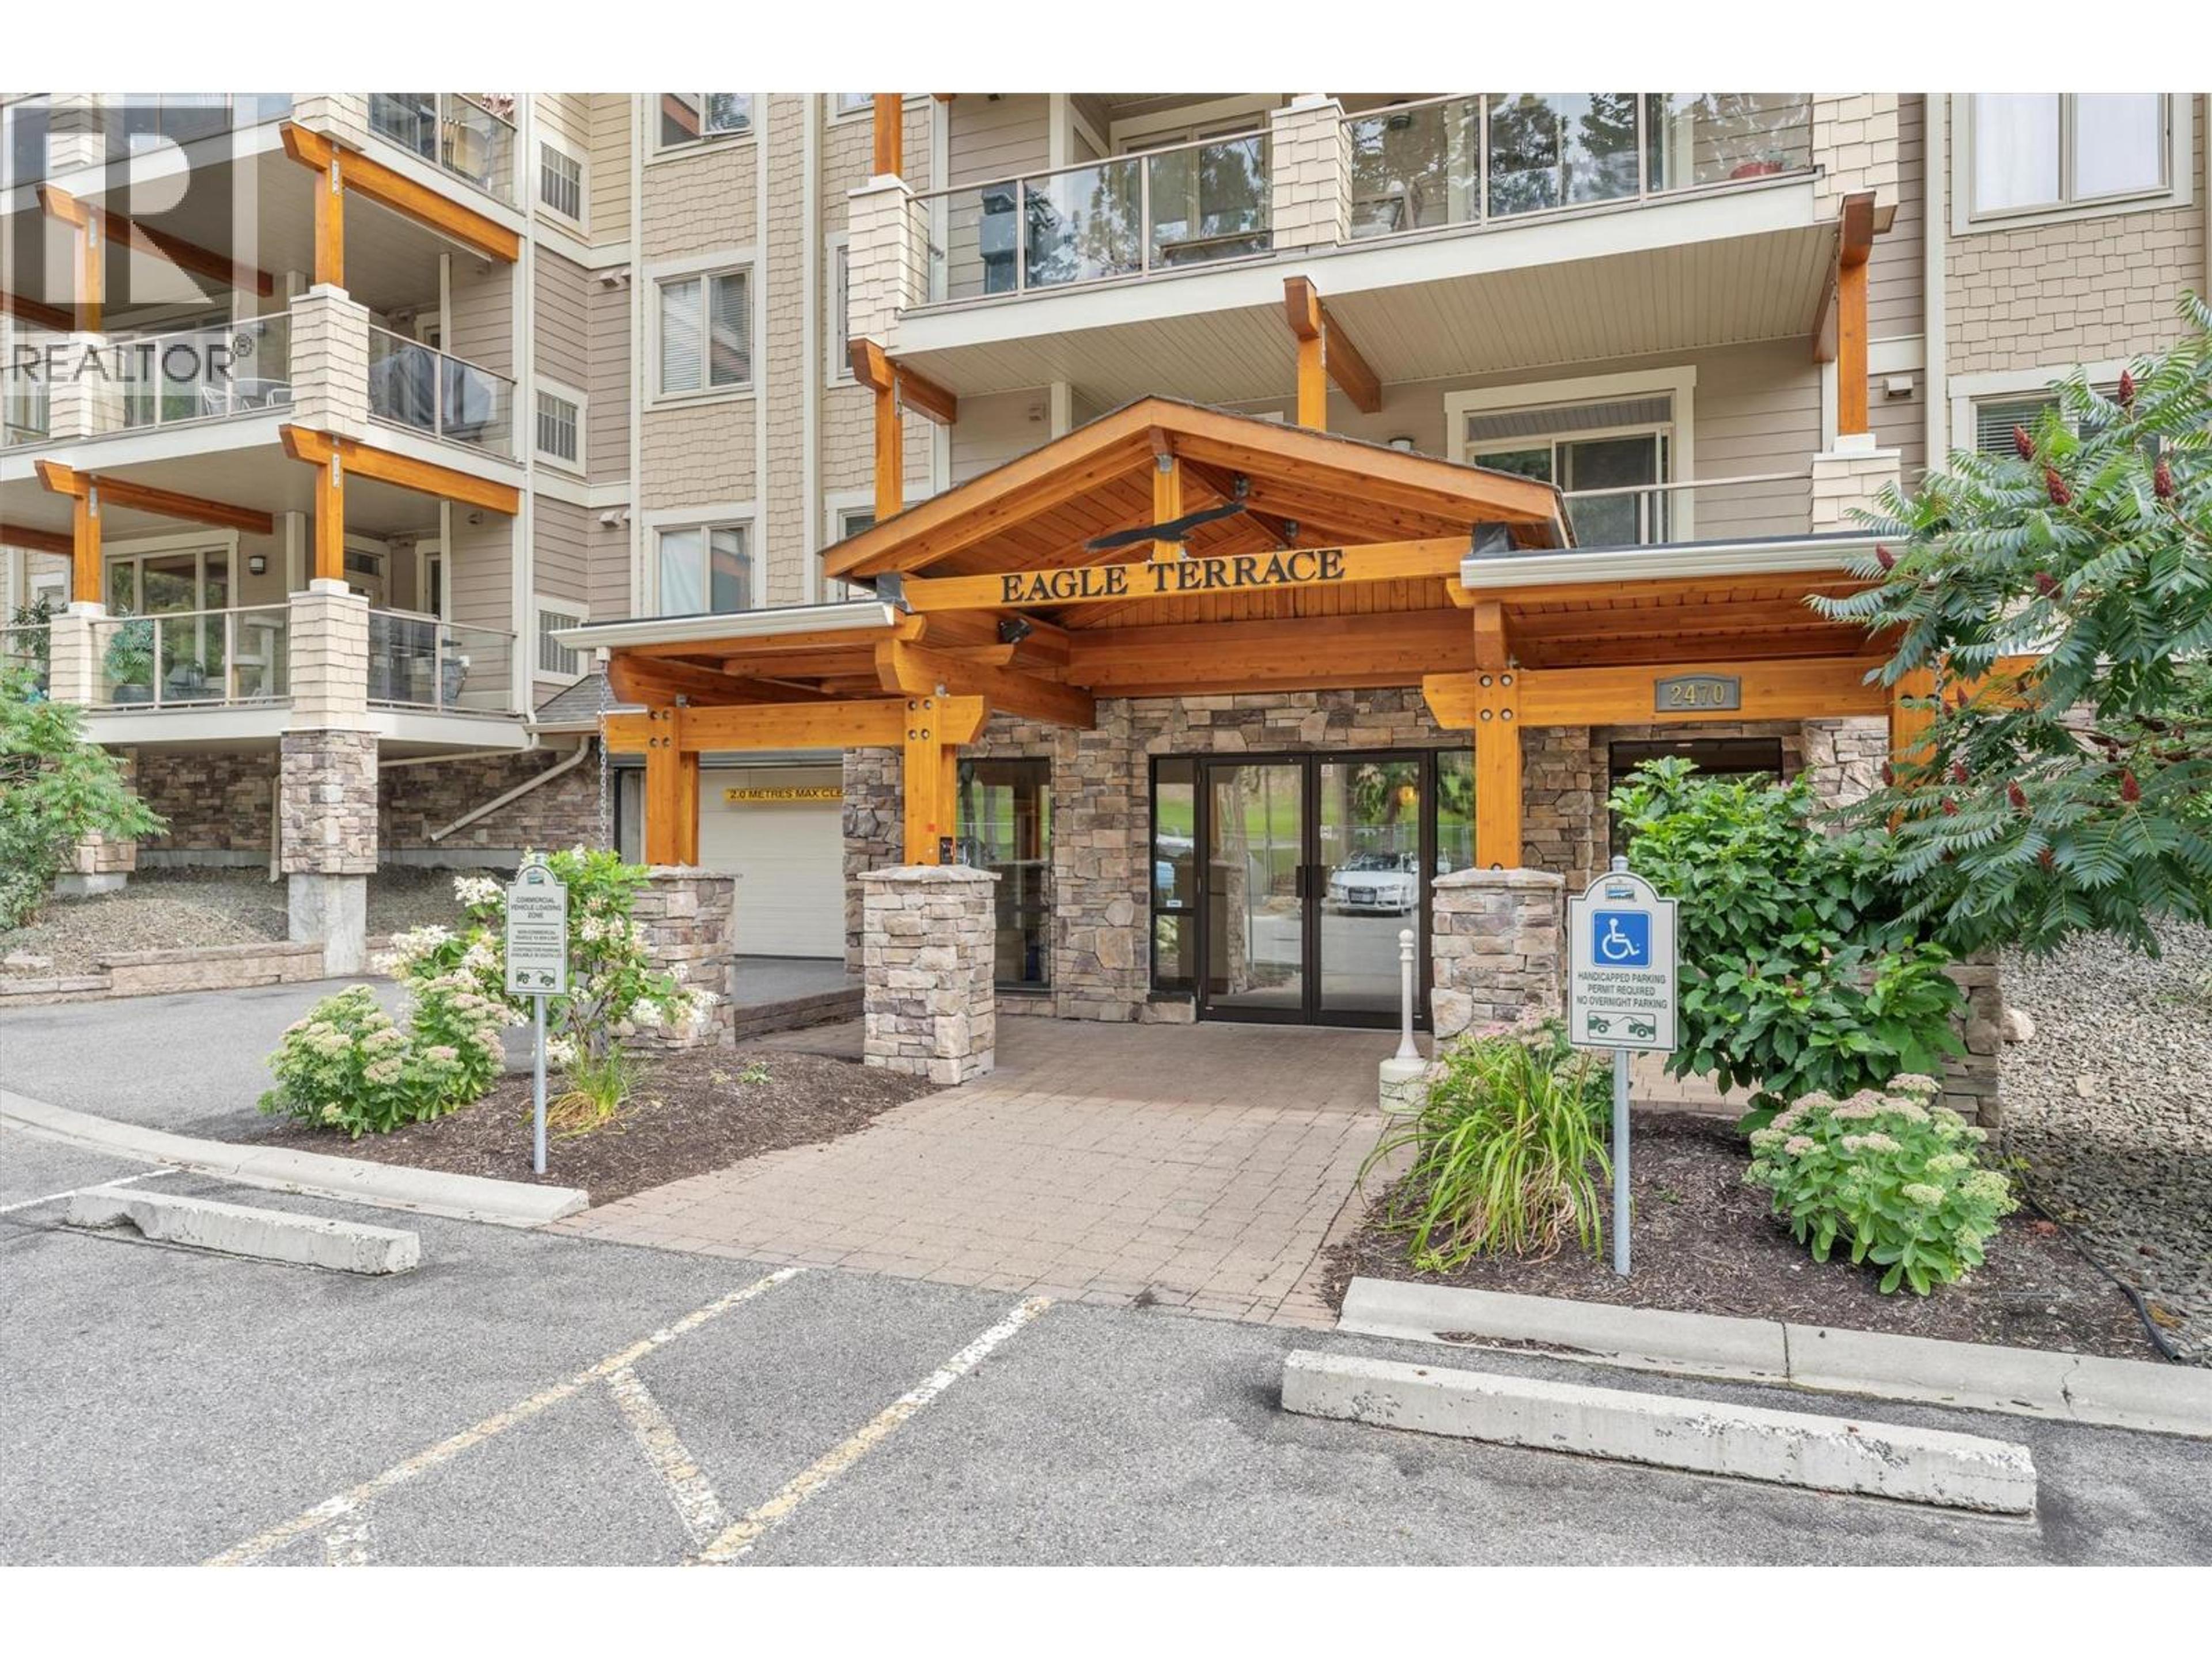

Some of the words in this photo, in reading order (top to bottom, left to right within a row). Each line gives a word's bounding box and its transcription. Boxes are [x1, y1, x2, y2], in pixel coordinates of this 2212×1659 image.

[1001, 566, 1128, 603] EAGLE
[1147, 548, 1346, 593] TERRACE
[1671, 684, 1725, 706] 2470
[729, 789, 746, 799] 2.0
[749, 789, 794, 799] METRES
[796, 789, 818, 798] MAX
[1577, 972, 1631, 983] HANDICAPPED
[1632, 973, 1666, 984] PARKING
[1588, 984, 1614, 994] PERMIT
[1616, 985, 1656, 996] REQUIRED
[1576, 995, 1588, 1005] NO
[1589, 996, 1631, 1007] OVERNIGHT
[1633, 998, 1667, 1009] PARKING
